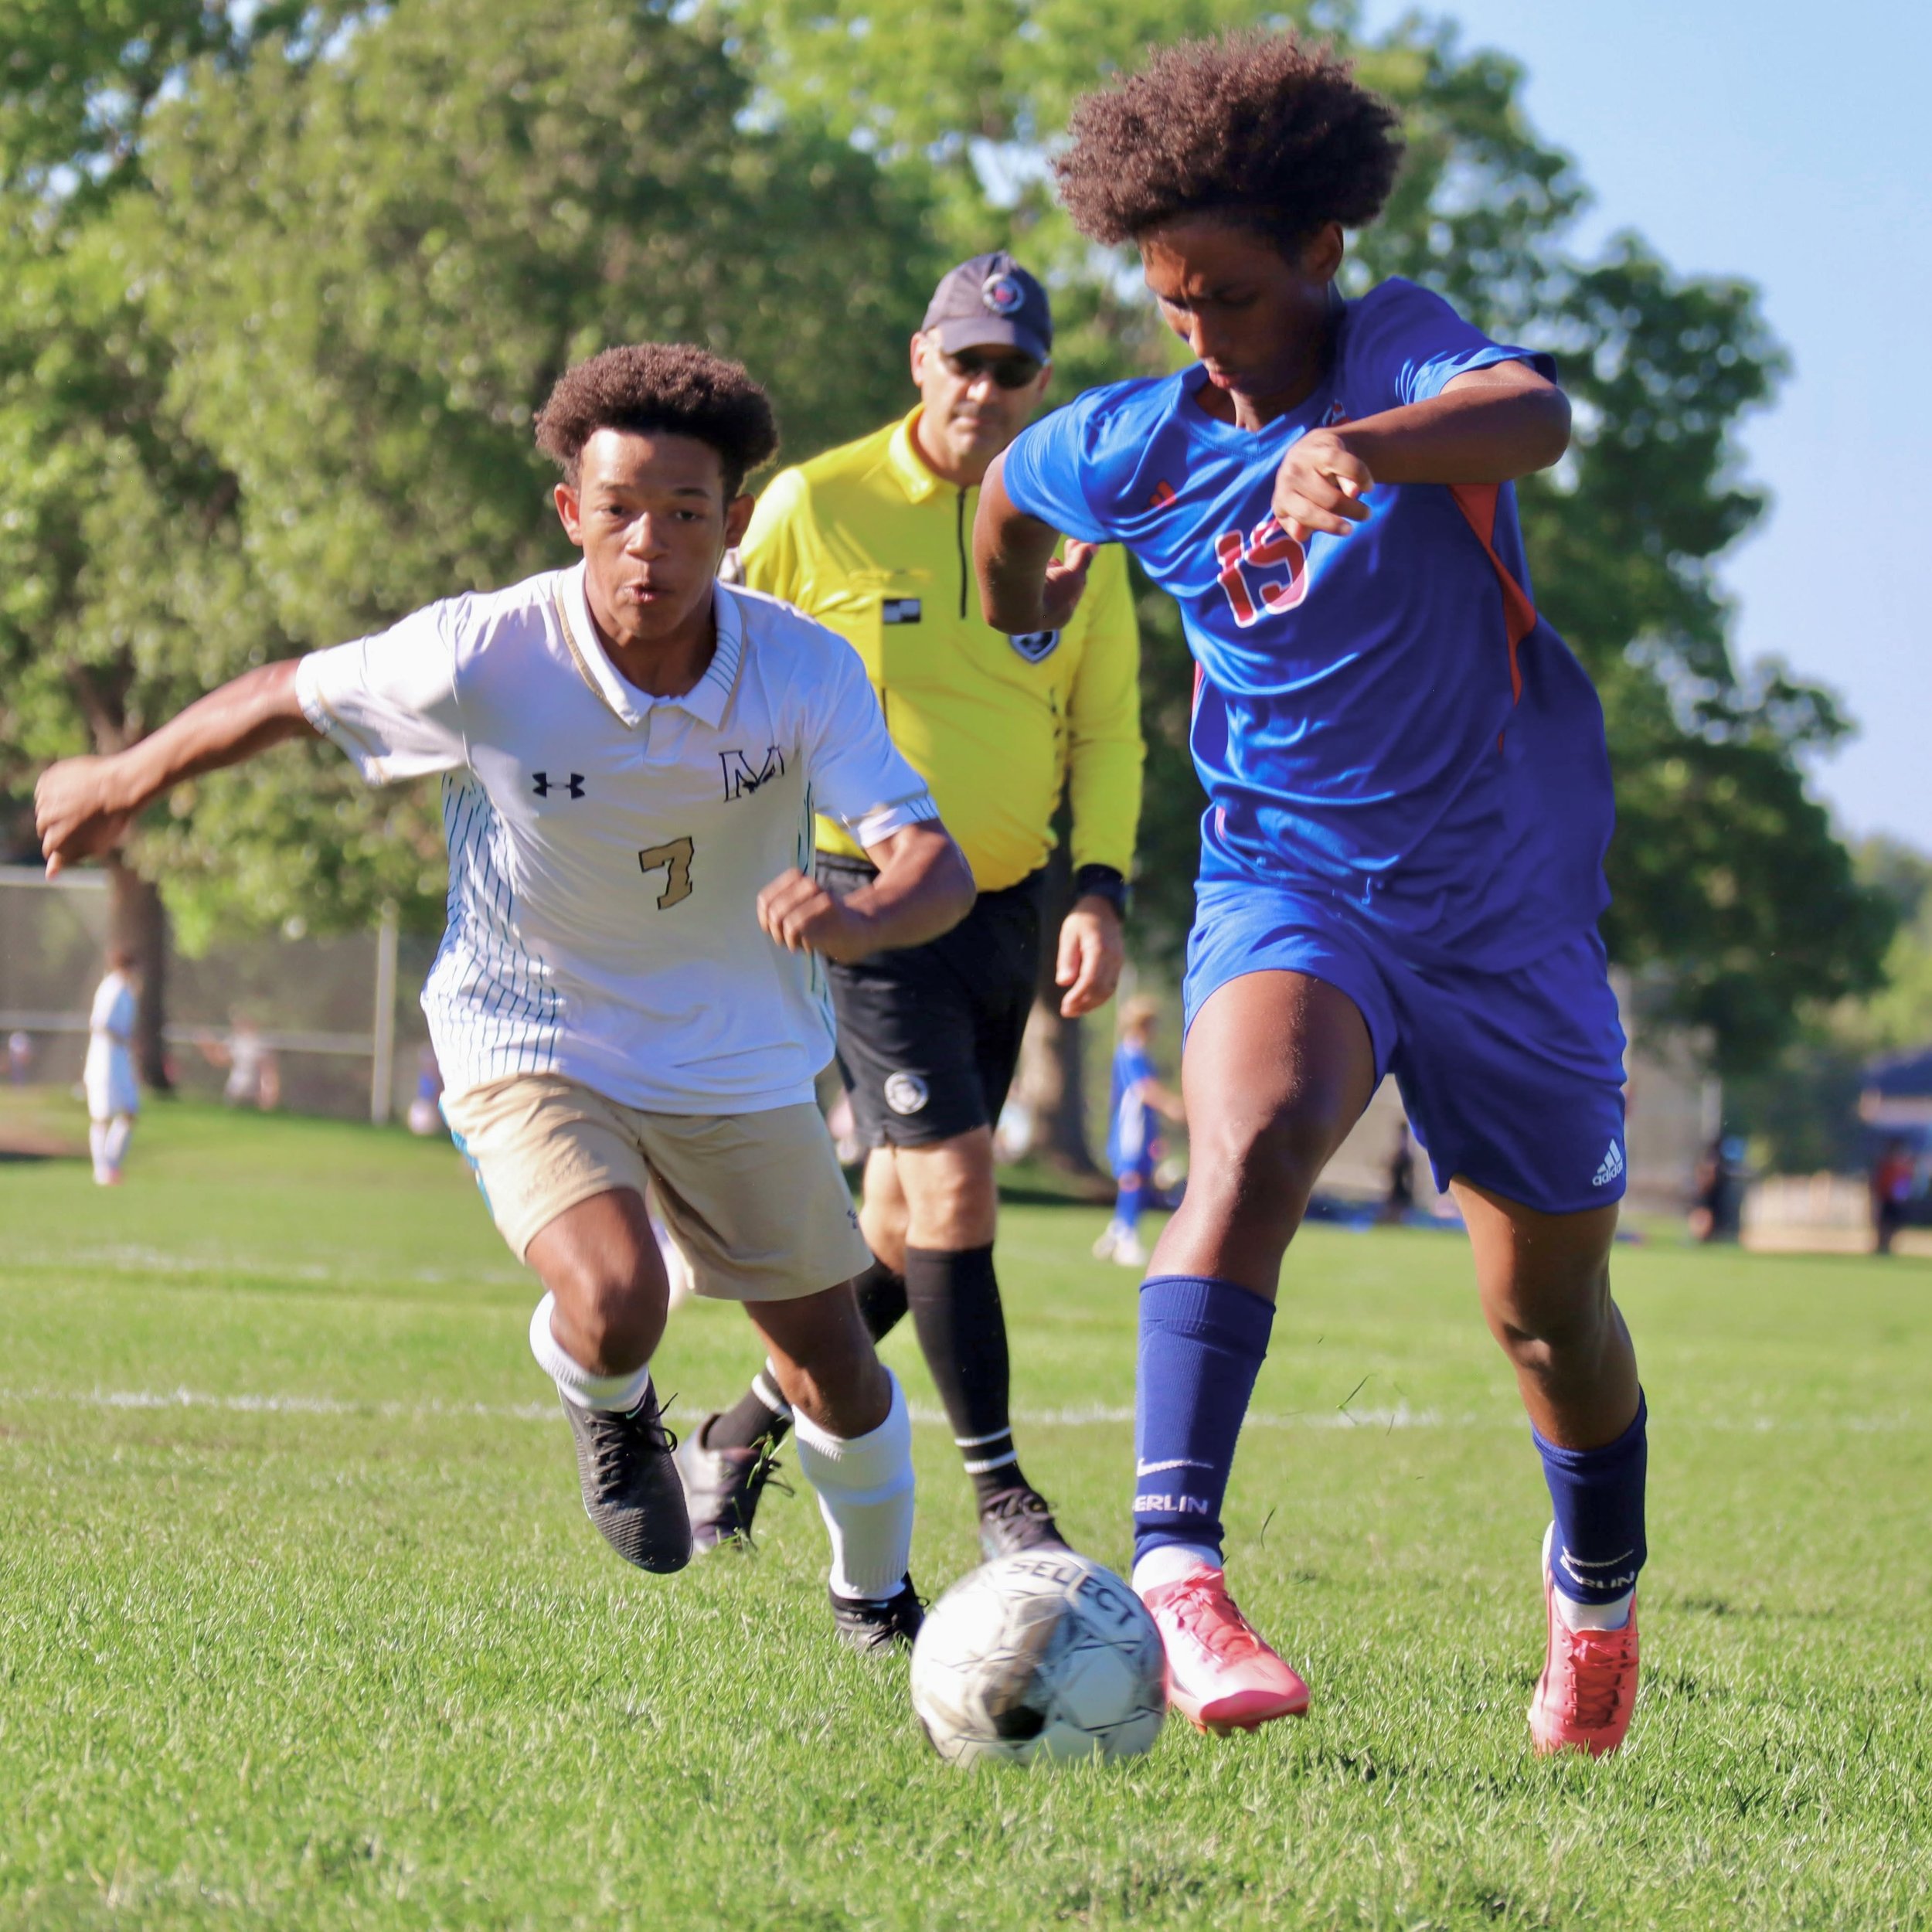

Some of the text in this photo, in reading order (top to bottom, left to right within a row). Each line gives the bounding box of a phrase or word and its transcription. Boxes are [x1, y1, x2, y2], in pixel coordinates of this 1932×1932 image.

[1215, 518, 1308, 628] 15
[638, 835, 694, 910] 7
[1131, 1494, 1209, 1515] ERLIN
[1007, 1560, 1136, 1625] SELECT
